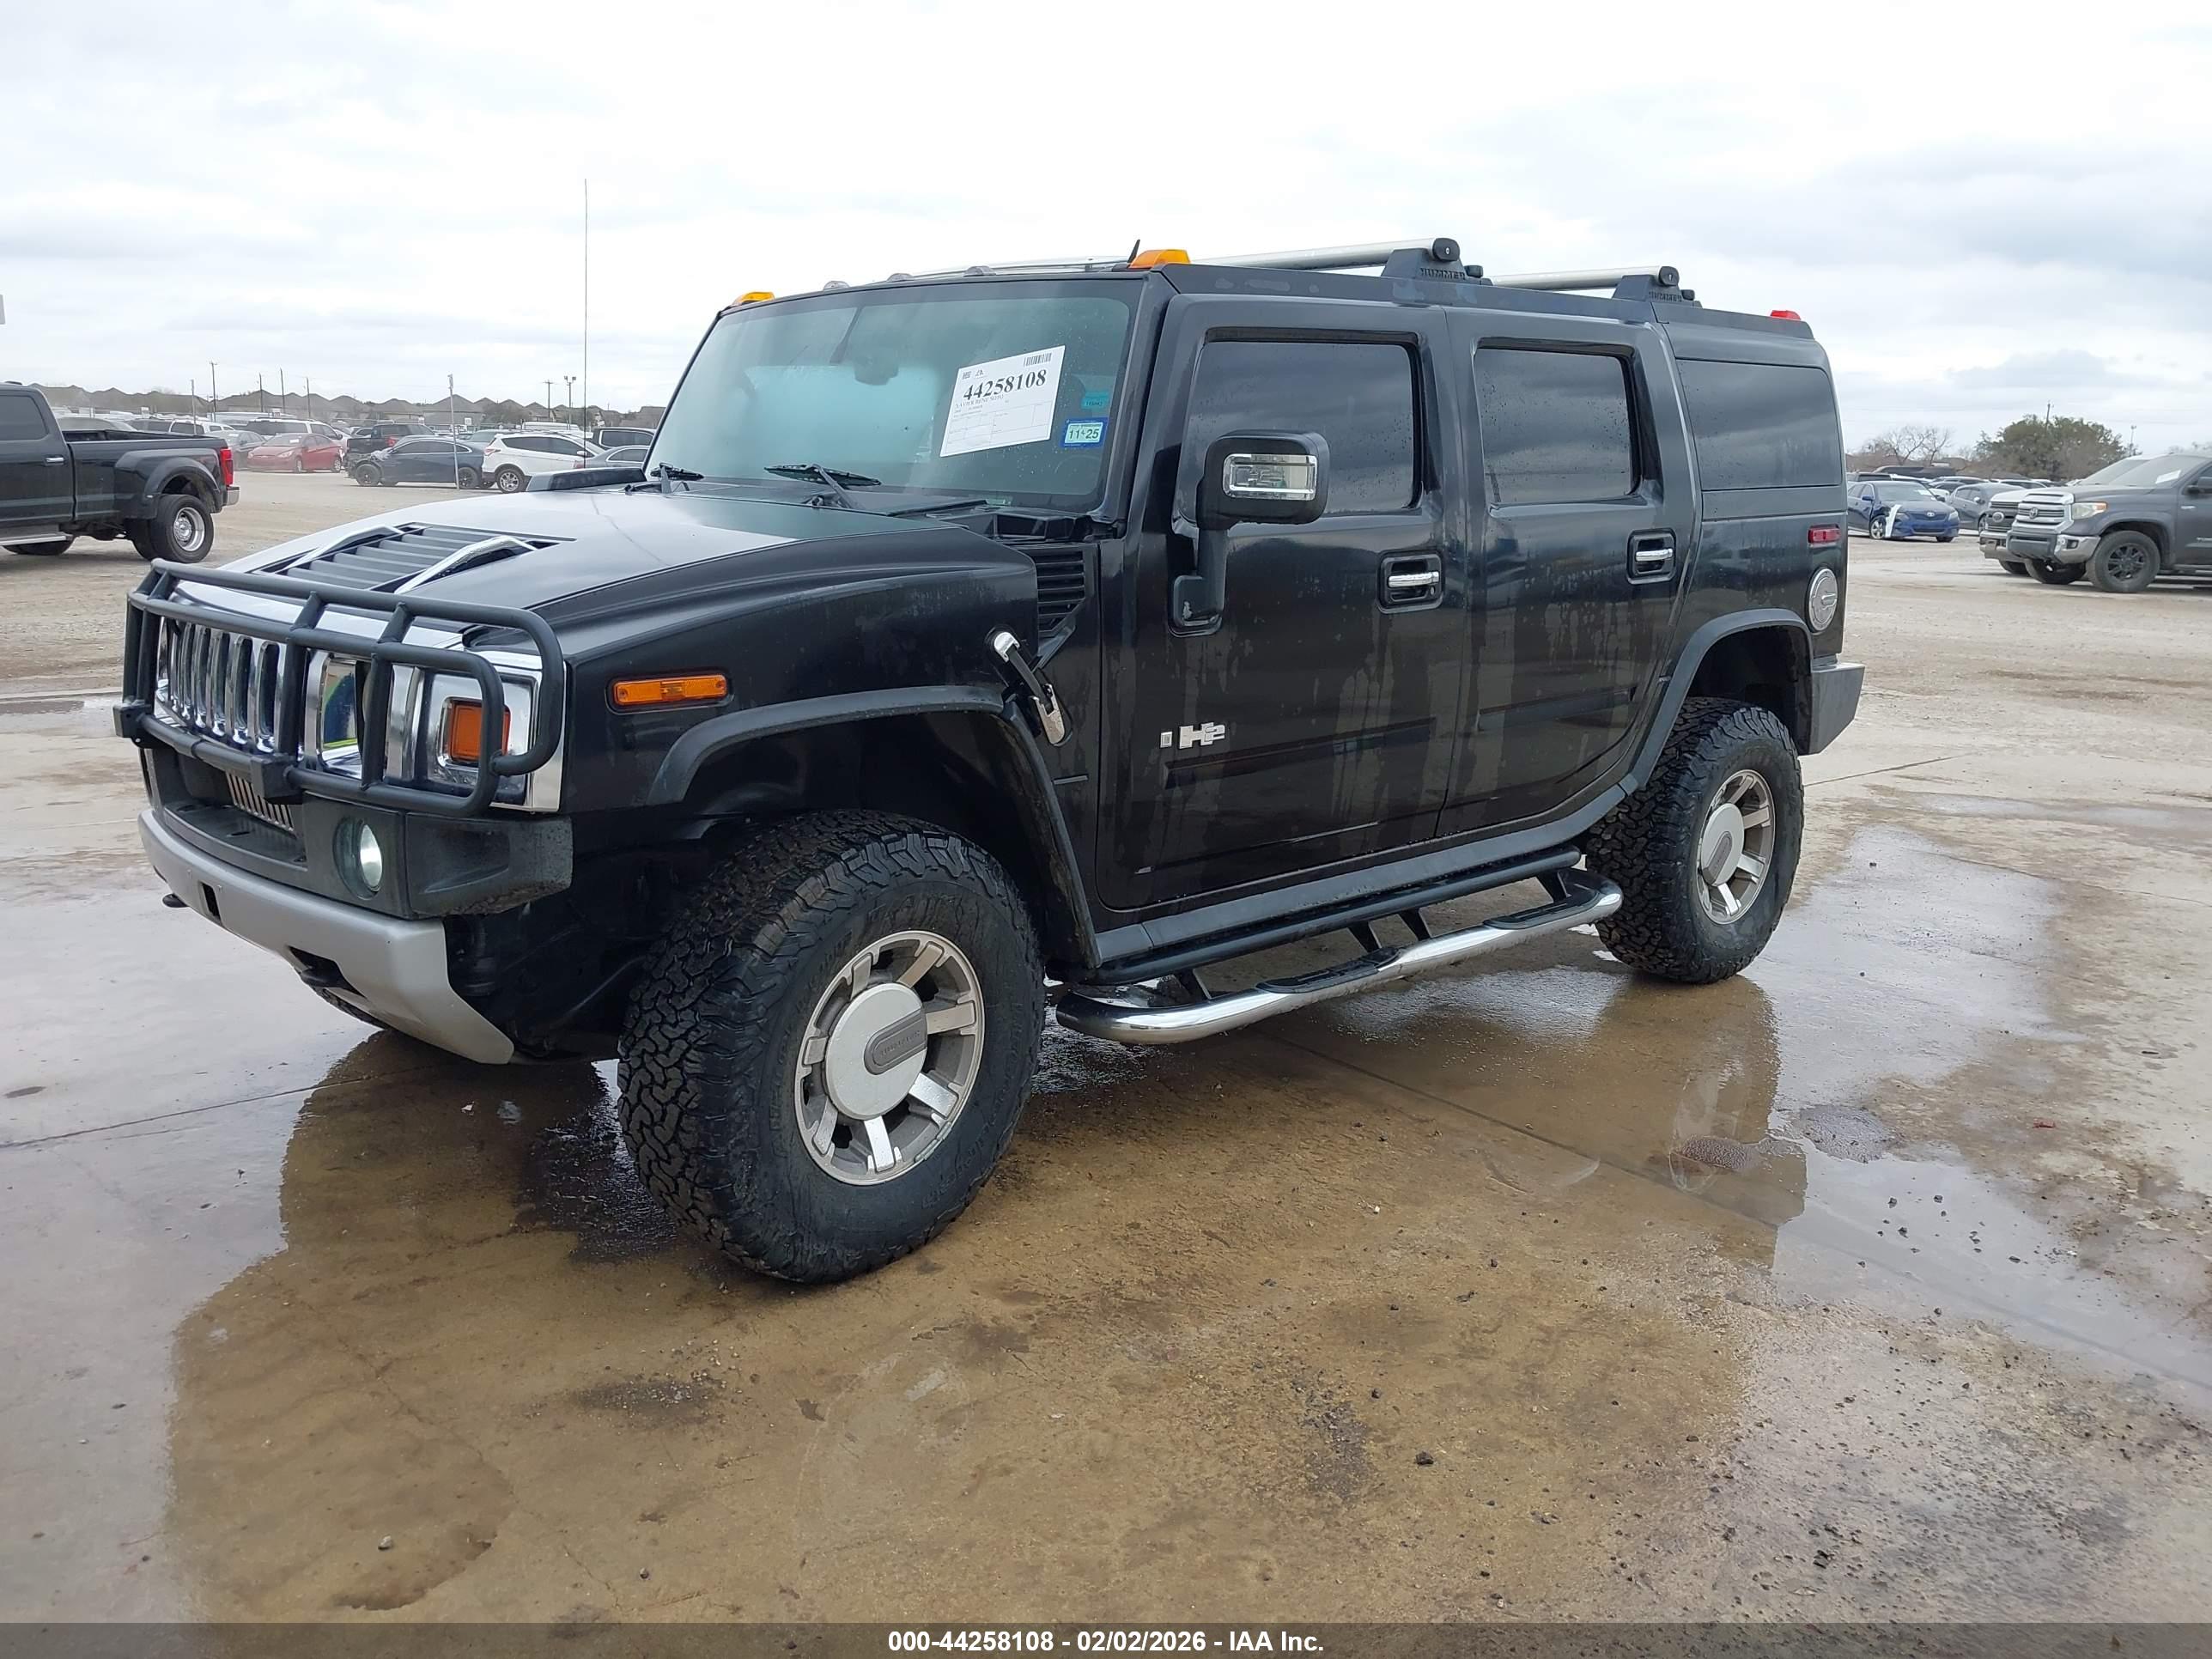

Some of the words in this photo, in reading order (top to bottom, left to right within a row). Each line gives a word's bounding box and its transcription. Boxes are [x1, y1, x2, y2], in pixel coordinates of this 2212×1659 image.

[963, 369, 1047, 400] 44258108
[1085, 428, 1099, 439] 25
[1179, 721, 1225, 750] H2
